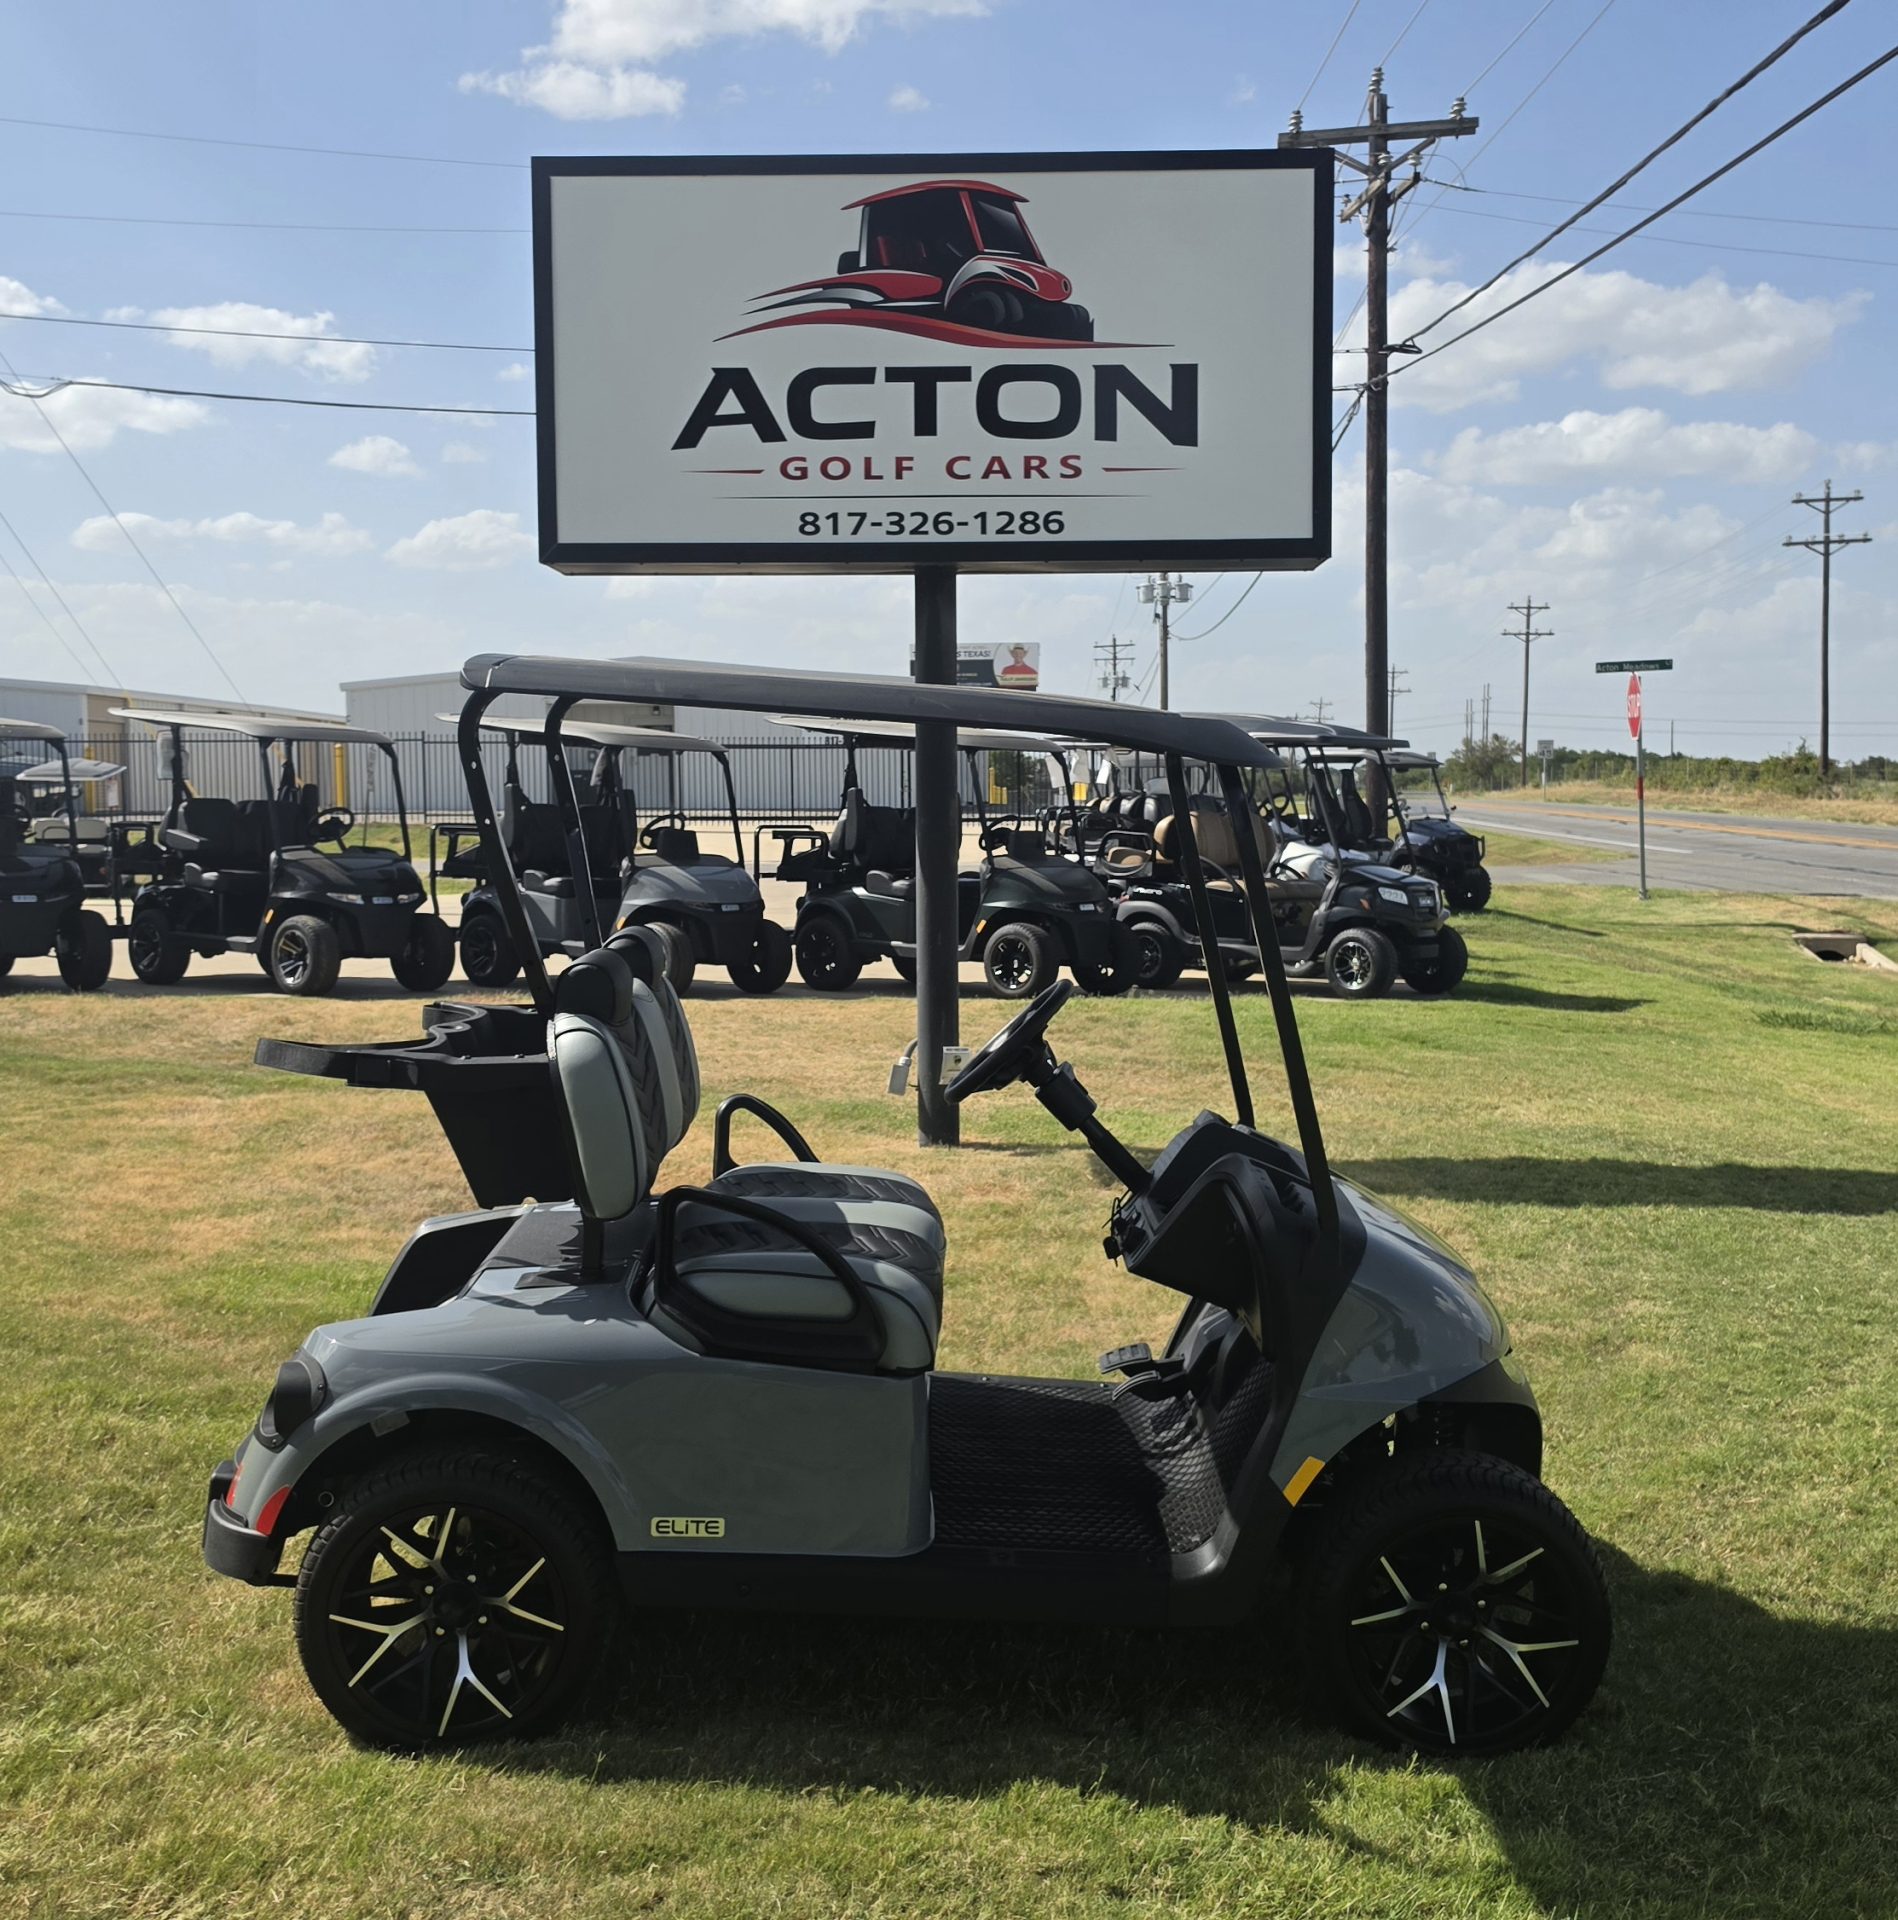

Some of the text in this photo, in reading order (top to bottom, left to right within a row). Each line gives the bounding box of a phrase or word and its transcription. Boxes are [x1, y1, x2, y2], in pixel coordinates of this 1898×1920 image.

[671, 363, 1198, 450] ACTON
[779, 454, 1082, 480] GOLF CARS
[798, 510, 1065, 536] 817-326-1286
[1597, 664, 1620, 672] Acton
[1623, 663, 1660, 671] Meadows
[1627, 692, 1641, 718] STOP
